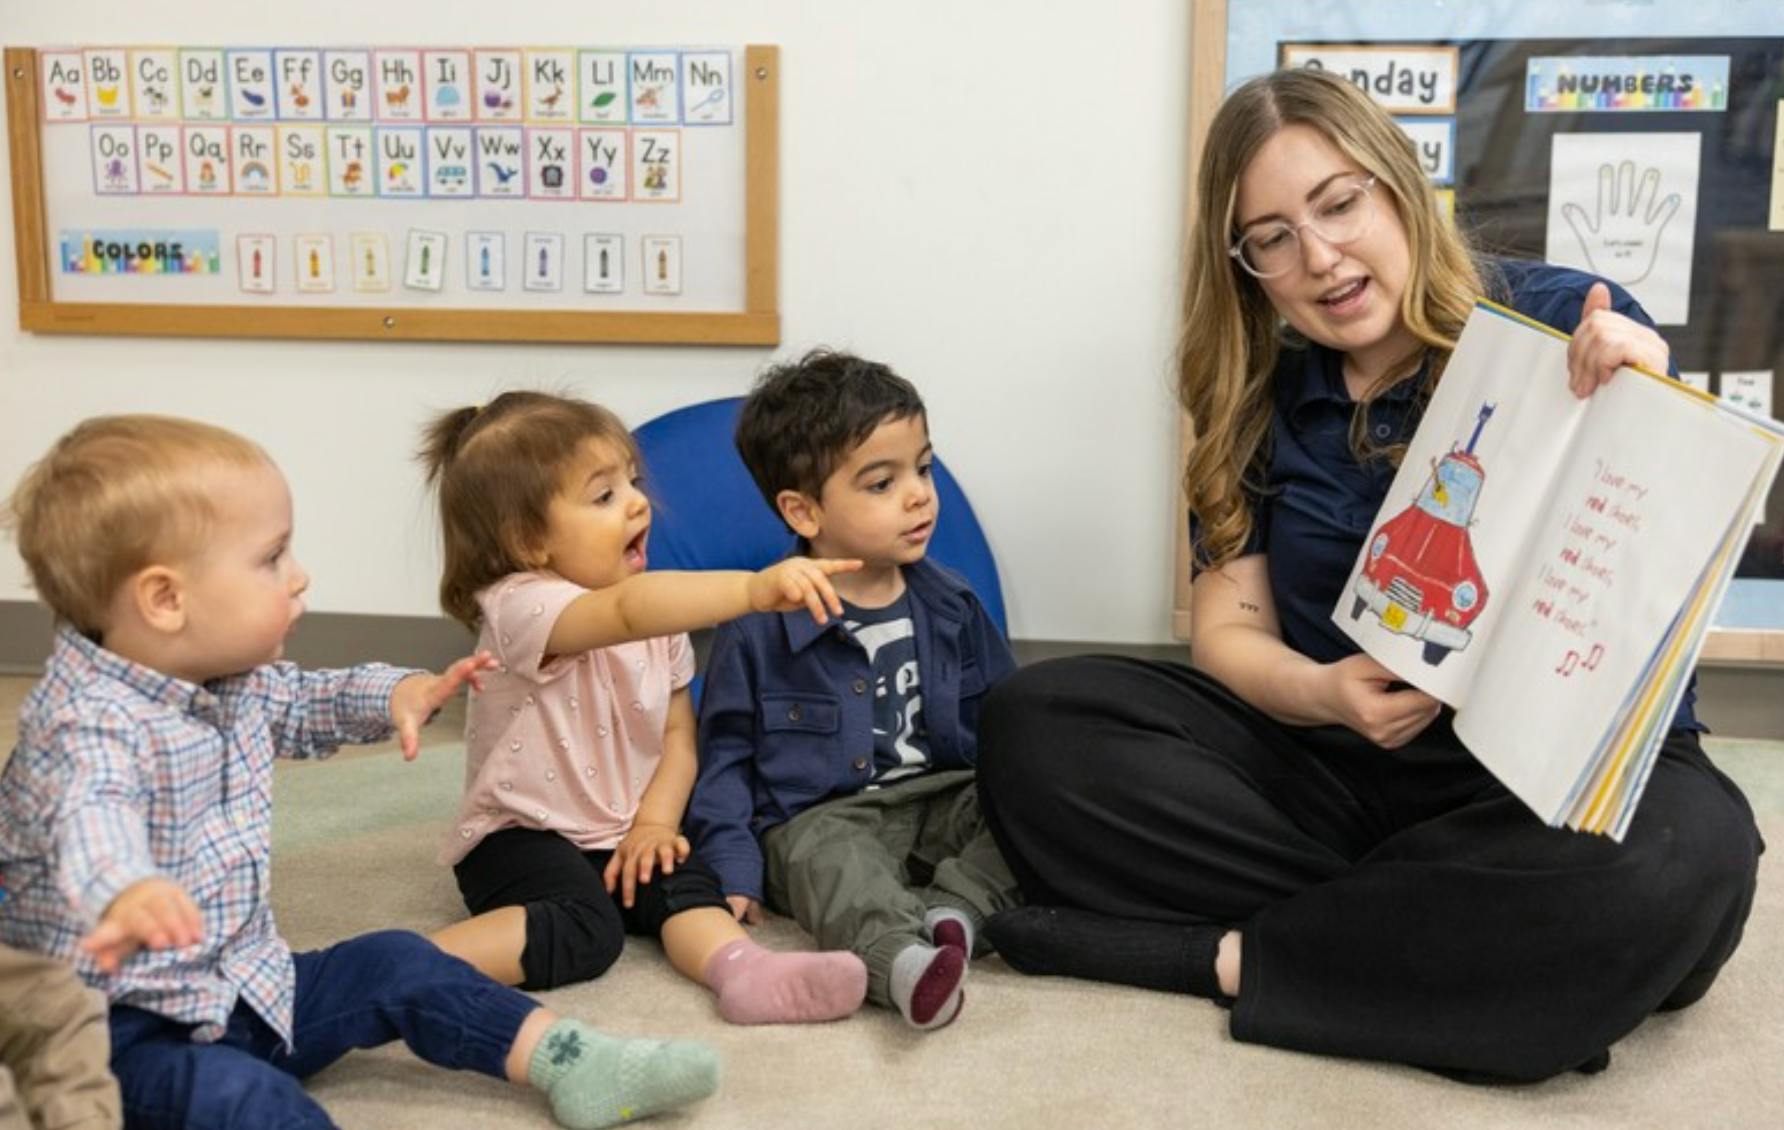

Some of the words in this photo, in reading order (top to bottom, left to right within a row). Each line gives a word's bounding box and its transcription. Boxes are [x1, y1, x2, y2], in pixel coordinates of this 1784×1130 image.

[48, 59, 80, 84] Aa
[91, 57, 121, 83] Bb
[138, 57, 169, 83] Cc
[187, 58, 218, 83] Dd
[235, 57, 265, 83] Ee
[282, 57, 313, 82] Ff
[331, 59, 364, 90] Gg
[382, 60, 414, 83] Hh
[437, 58, 456, 83] Ii
[486, 58, 512, 90] Jj
[534, 59, 565, 83] Kk
[633, 60, 674, 83] Mm
[690, 61, 722, 86] Nn
[1303, 57, 1438, 104] nday
[1557, 73, 1693, 93] NUMBERS
[98, 133, 129, 158] Oo
[145, 133, 174, 162] Pp
[189, 133, 226, 163] Qq
[239, 133, 267, 158] Rr
[286, 133, 315, 159] Ss
[335, 134, 365, 159] Tt
[384, 135, 415, 160] Uu
[435, 136, 466, 159] Vv
[480, 136, 521, 156] Ww
[537, 136, 565, 161] Xx
[586, 137, 617, 168] Yy
[640, 138, 670, 164] Zz
[92, 239, 184, 260] COLORS
